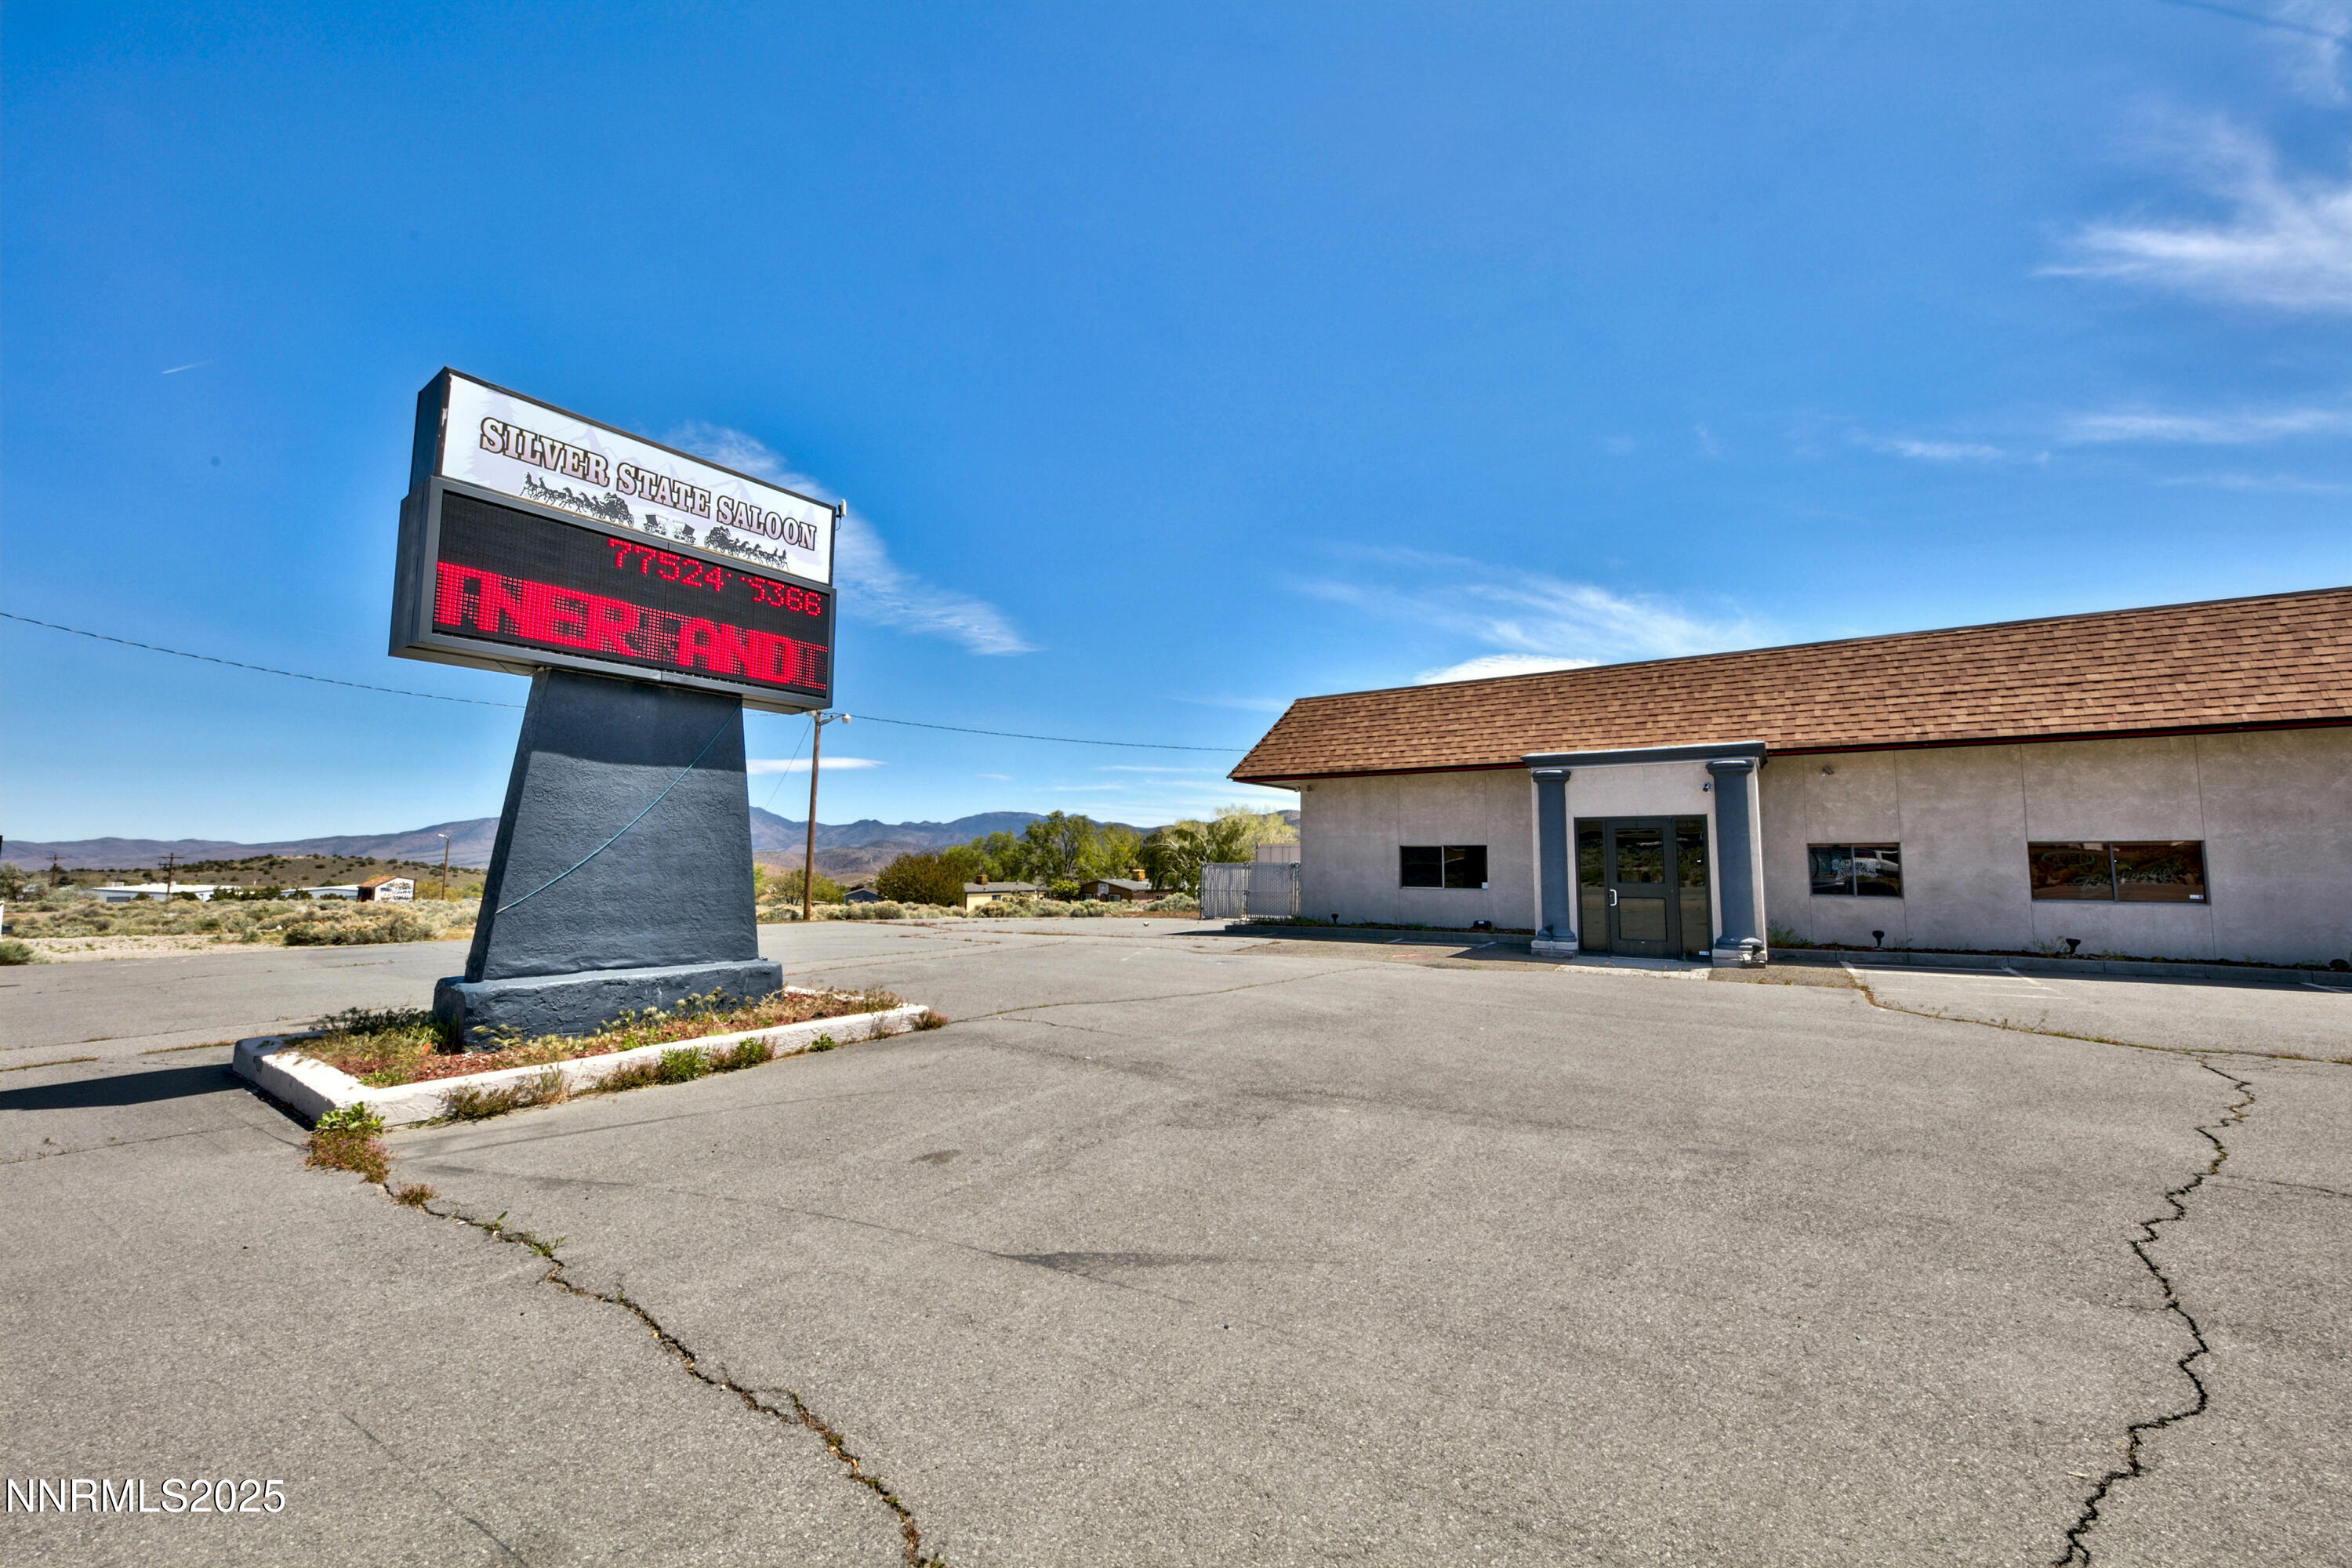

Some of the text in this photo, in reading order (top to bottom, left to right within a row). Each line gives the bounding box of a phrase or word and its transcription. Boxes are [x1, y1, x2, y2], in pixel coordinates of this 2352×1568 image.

[480, 417, 817, 550] SILVER STATE SALOON
